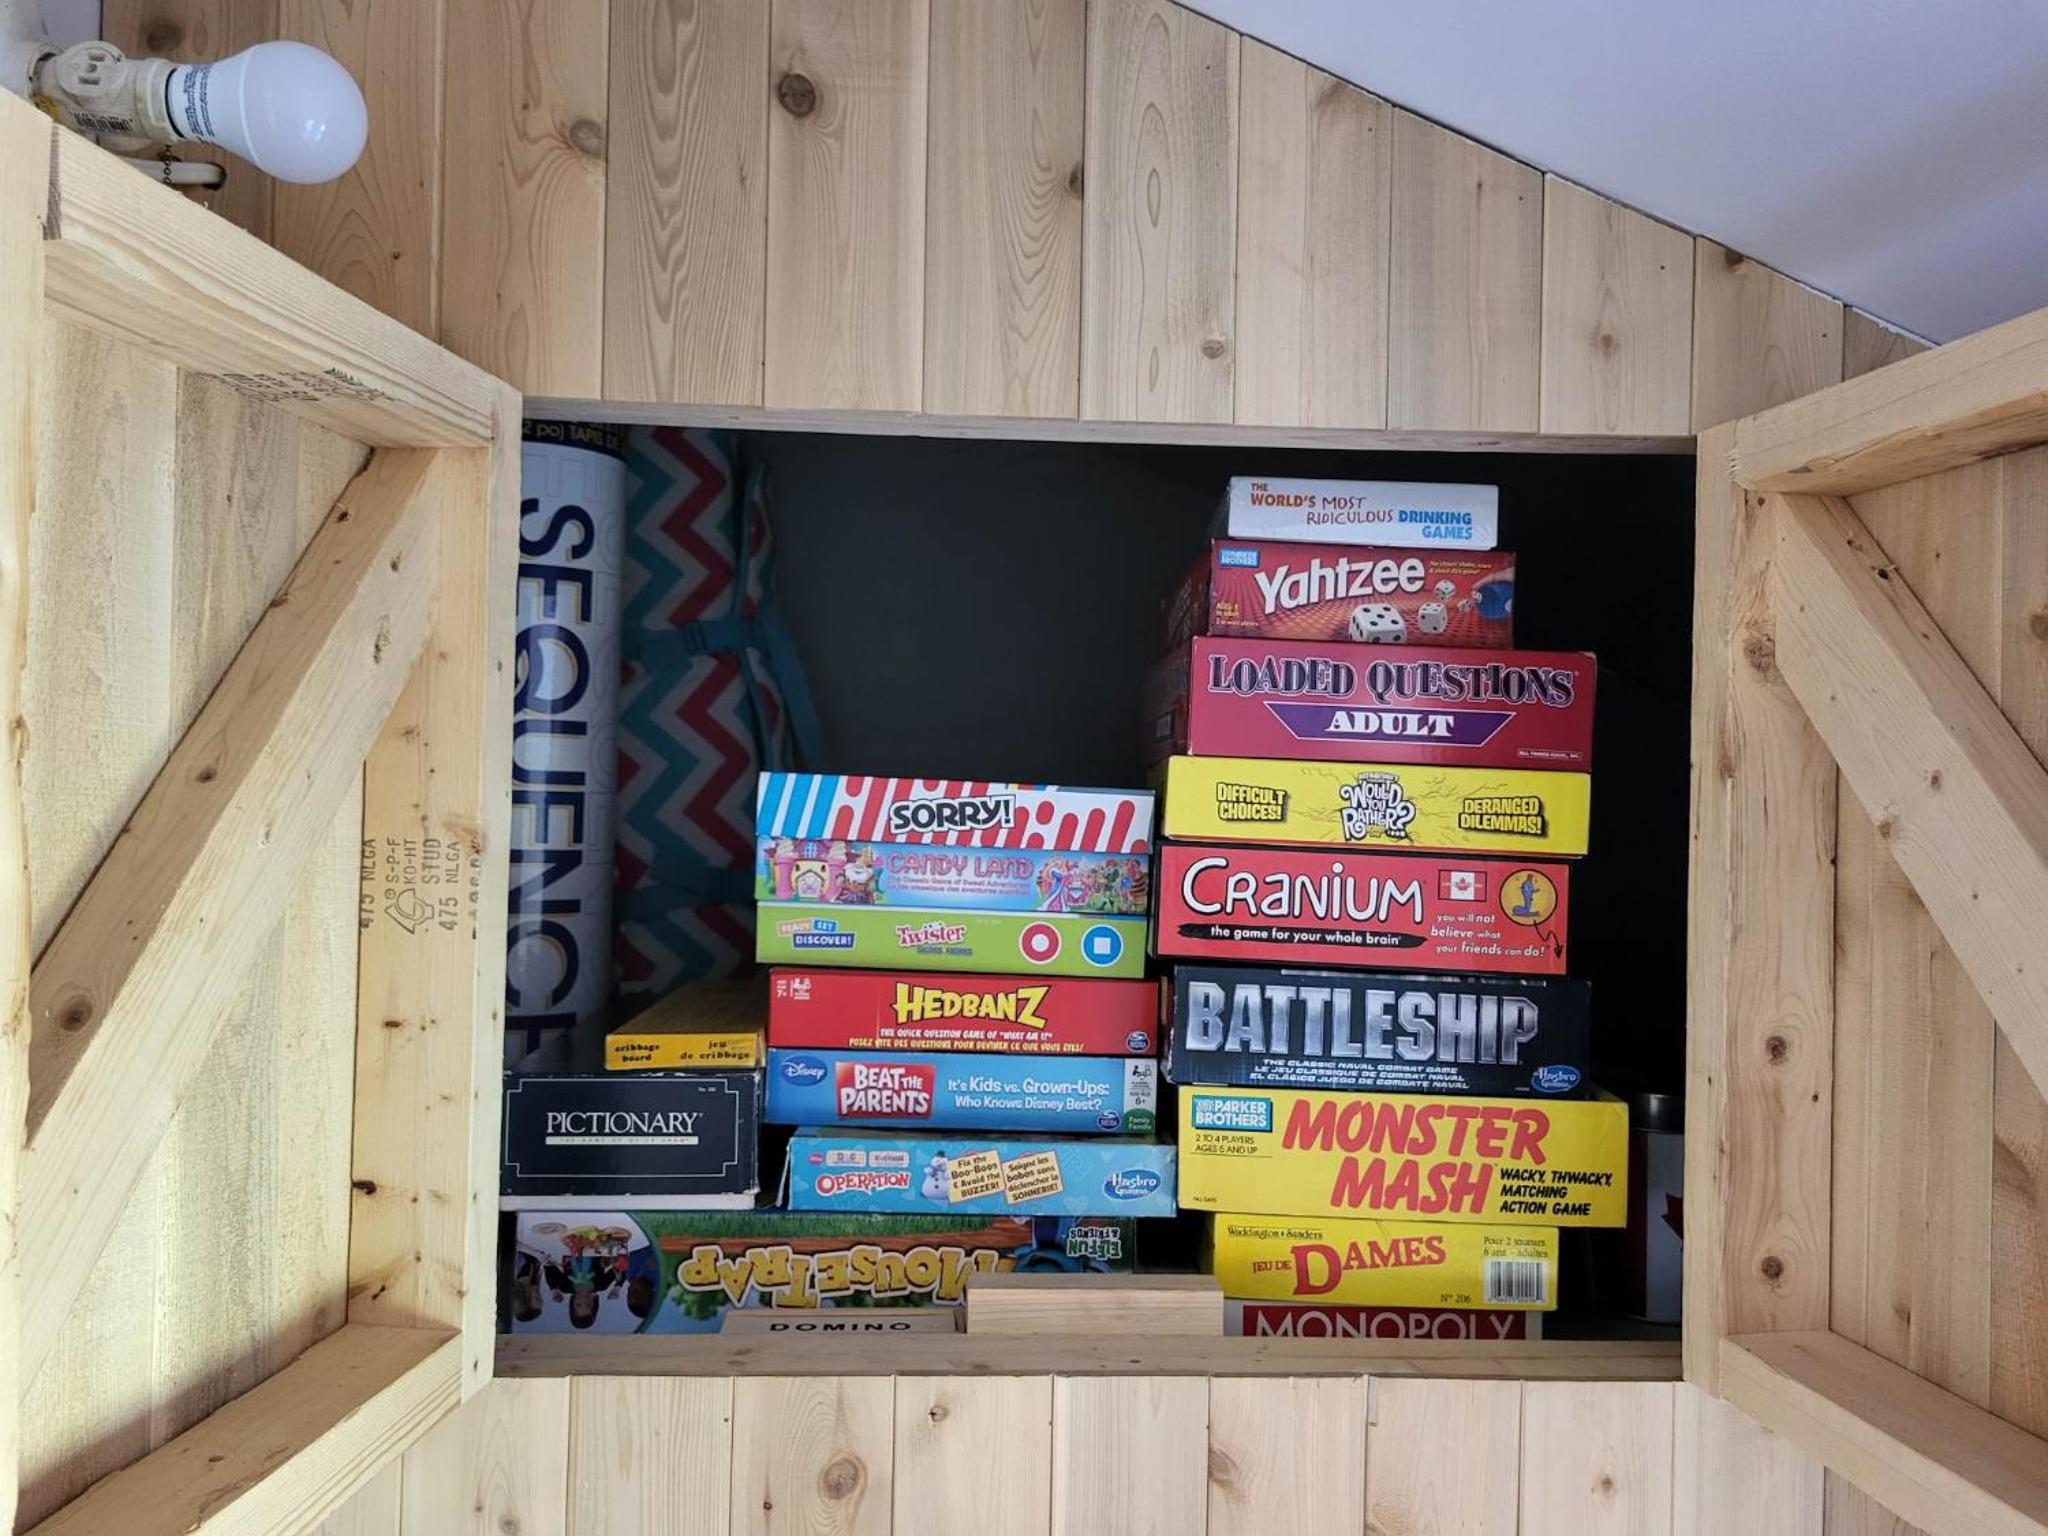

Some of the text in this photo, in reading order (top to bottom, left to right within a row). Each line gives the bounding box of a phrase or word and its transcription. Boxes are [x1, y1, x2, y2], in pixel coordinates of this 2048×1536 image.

[1251, 483, 1268, 492] THE
[1250, 493, 1366, 510] WORLD'S MOST
[1307, 509, 1472, 525] RIDICULOUS DRINKING
[1422, 525, 1472, 540] GAMES
[1254, 556, 1425, 616] Yahtzee
[1208, 655, 1575, 706] LOADED QUESTIONS
[1324, 711, 1455, 737] ADULT
[1217, 783, 1287, 803] DIFFICULT
[1340, 782, 1402, 808] WOULD
[1219, 803, 1283, 821] CHOICES!
[1366, 798, 1387, 811] YOU
[1464, 797, 1540, 816] DERANGED
[893, 799, 1011, 830] SORRY!
[1342, 801, 1416, 840] RATHER?
[1460, 813, 1543, 834] DILEMMAS!
[386, 837, 400, 883] S-P-F
[421, 838, 441, 885] STUD
[887, 852, 1034, 880] CANDY LAND
[438, 841, 460, 930] 475 NLGA
[816, 922, 834, 931] SET
[1437, 913, 1495, 923] you will not
[795, 935, 852, 946] DISCOVER!
[896, 926, 965, 945] Twister
[1211, 926, 1400, 946] the game for your whole brain
[1430, 926, 1501, 939] believe what
[1436, 941, 1545, 957] your friends can do!
[891, 982, 1050, 1030] HEDBANZ
[1185, 981, 1539, 1065] BATTLESHIP
[880, 1028, 894, 1037] THE
[897, 1028, 922, 1038] QUICK
[923, 1029, 961, 1039] QUESTION
[963, 1030, 985, 1039] GAME
[987, 1030, 998, 1039] OF
[615, 1043, 660, 1052] cribbage
[708, 1040, 727, 1049] jeu
[622, 1054, 652, 1062] board
[680, 1051, 751, 1060] de cribbage
[783, 1061, 825, 1080] Disney
[1287, 1060, 1336, 1068] CLASSIC
[1338, 1062, 1375, 1070] NAVAL
[1377, 1064, 1424, 1073] COMBAT
[1426, 1066, 1458, 1074] GAME
[1296, 1068, 1359, 1076] CLASSIQUE
[1379, 1071, 1426, 1080] COMBAT
[1428, 1074, 1465, 1082] NAVAL
[854, 1065, 924, 1090] BEAT THE
[1250, 1072, 1265, 1080] EL
[1317, 1076, 1355, 1084] JUEGO
[1376, 1078, 1430, 1088] COMBATE
[1432, 1081, 1470, 1089] NAVAL
[948, 1077, 1110, 1098] It's Kids vs. Grown-Ups:
[840, 1088, 930, 1115] PARENTS
[955, 1095, 1102, 1112] Who Knows Disney Best?
[1214, 1100, 1267, 1114] PARKER
[546, 1112, 699, 1134] PICTIONARY
[1196, 1112, 1267, 1127] BROTHERS
[1196, 1134, 1200, 1142] 2
[1203, 1134, 1213, 1142] TO
[1221, 1135, 1255, 1144] PLAYERS
[1282, 1099, 1550, 1165] MONSTER
[1195, 1143, 1258, 1154] AGES AND UP
[951, 1163, 998, 1179] Boo-Boos
[958, 1160, 971, 1168] Fix
[816, 1172, 911, 1196] OPERATION
[961, 1173, 1000, 1188] Avoid the
[1007, 1170, 1034, 1181] bobos
[1108, 1173, 1157, 1189] Hasbro
[1500, 1168, 1613, 1187] WACKY, THWACKY,
[961, 1181, 1000, 1197] BUZZER!
[1330, 1156, 1494, 1214] MASH
[1500, 1184, 1567, 1199] MATCHING
[1500, 1200, 1591, 1216] ACTION GAME
[1069, 1239, 1120, 1258] ELEFUN
[1506, 1236, 1511, 1246] 2
[1484, 1246, 1489, 1256] 6
[1253, 1235, 1446, 1295] JEU DE DAMES
[770, 1322, 911, 1332] DOMINO
[1256, 1310, 1515, 1340] MONOPOLY
